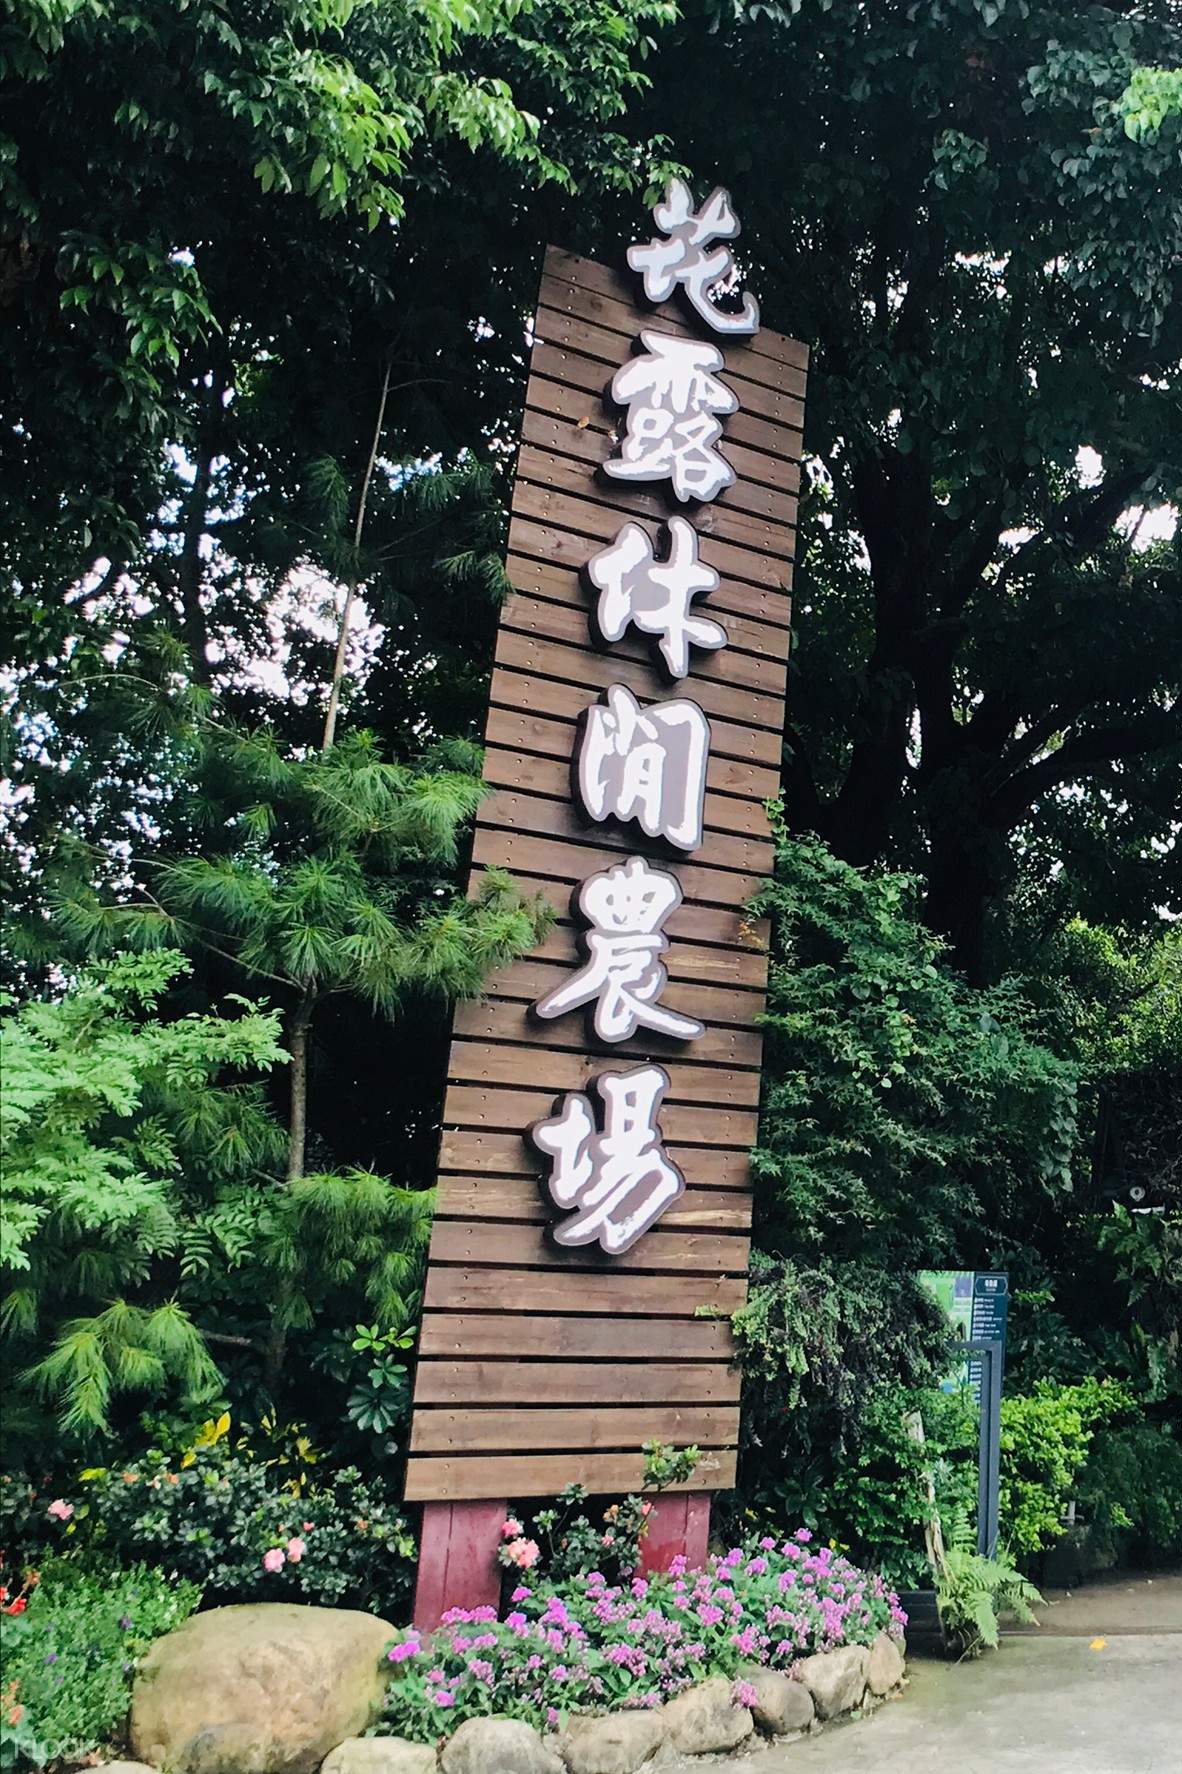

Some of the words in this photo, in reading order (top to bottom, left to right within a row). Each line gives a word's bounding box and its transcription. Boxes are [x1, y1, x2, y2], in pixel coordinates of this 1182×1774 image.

[531, 179, 759, 1256] 花露休閒農場
